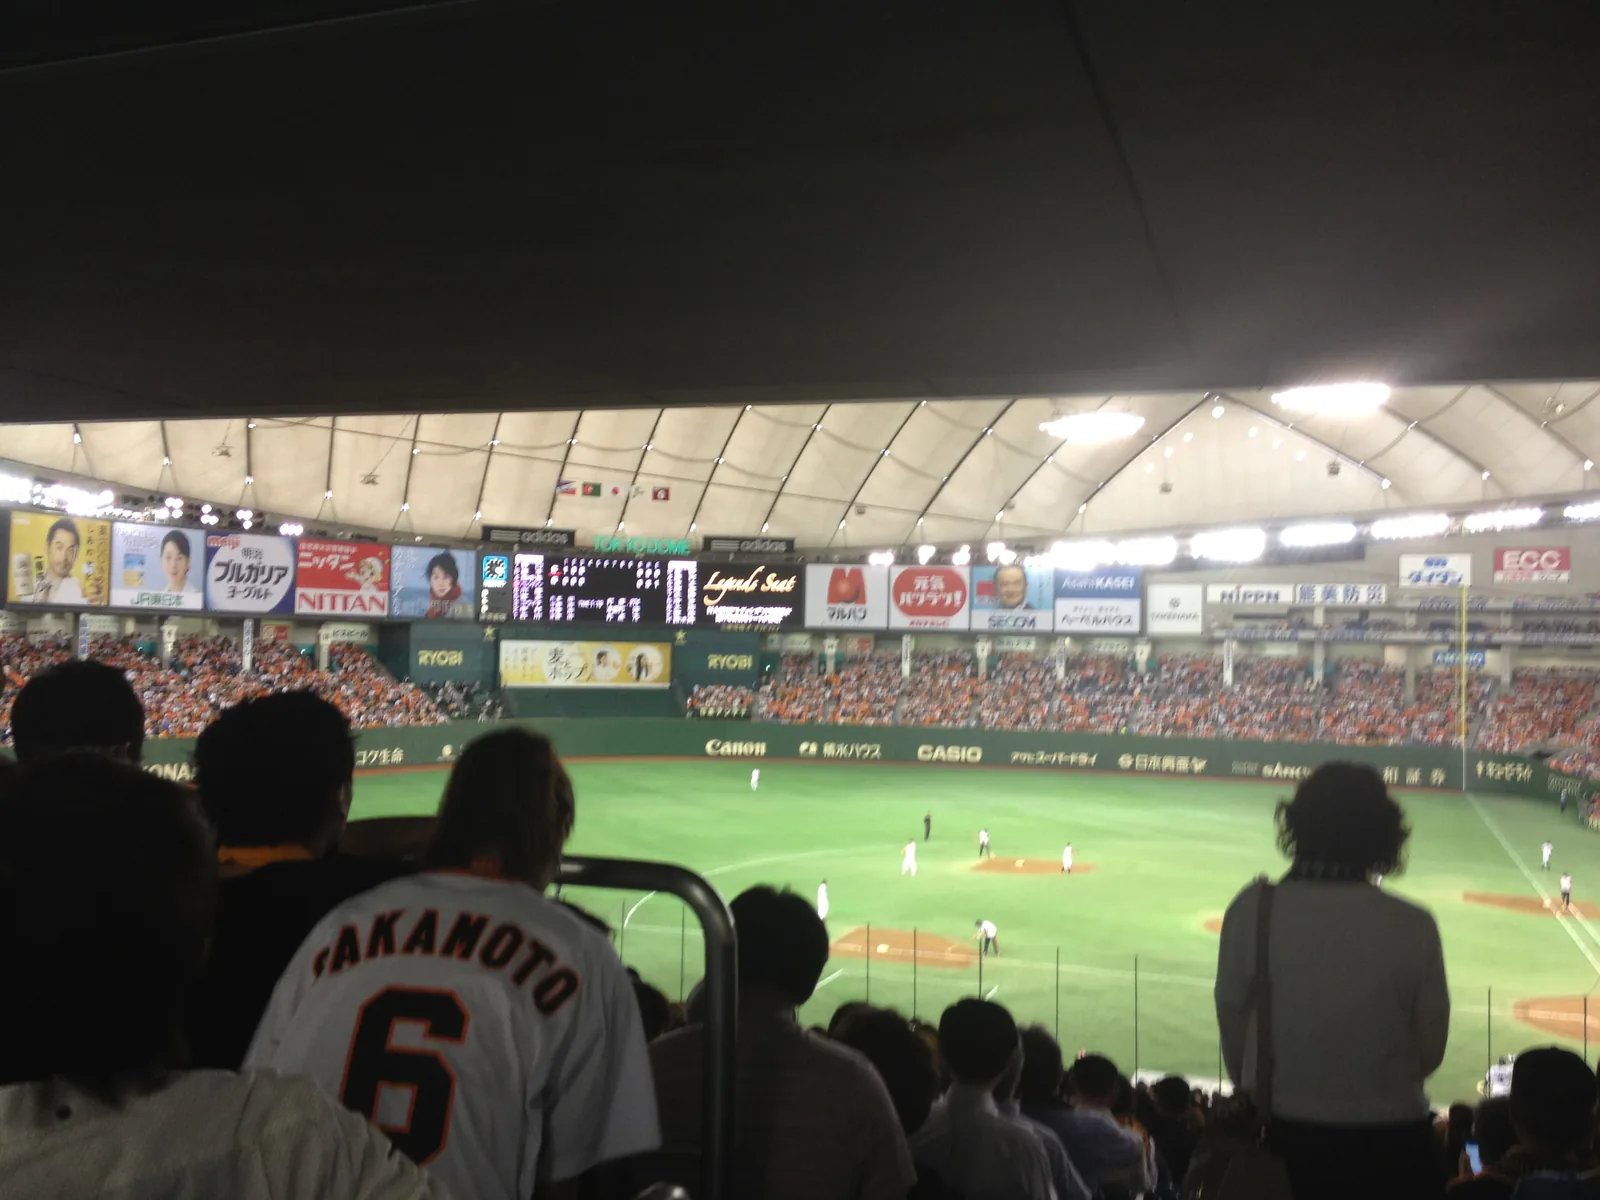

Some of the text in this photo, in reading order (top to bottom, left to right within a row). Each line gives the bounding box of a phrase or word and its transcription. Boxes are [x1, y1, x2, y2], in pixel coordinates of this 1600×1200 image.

[207, 533, 241, 550] meiji
[521, 531, 568, 545] adidas
[593, 535, 692, 555] TOKYO DOME
[739, 540, 787, 552] adidas
[1502, 550, 1561, 569] ECC
[214, 559, 289, 585] ブルガリア
[761, 572, 796, 593] Seat
[914, 575, 945, 591] 元気
[226, 585, 273, 601] ヨーグルト
[299, 591, 387, 612] NITTAN
[1299, 585, 1384, 604] 能美防災
[988, 615, 1036, 630] SECOM
[417, 650, 463, 667] RYOBI
[707, 653, 753, 670] RYOBI
[356, 747, 404, 766] コク生命
[705, 739, 766, 757] Canon
[917, 744, 983, 763] CASIO
[339, 984, 470, 1167] 6
